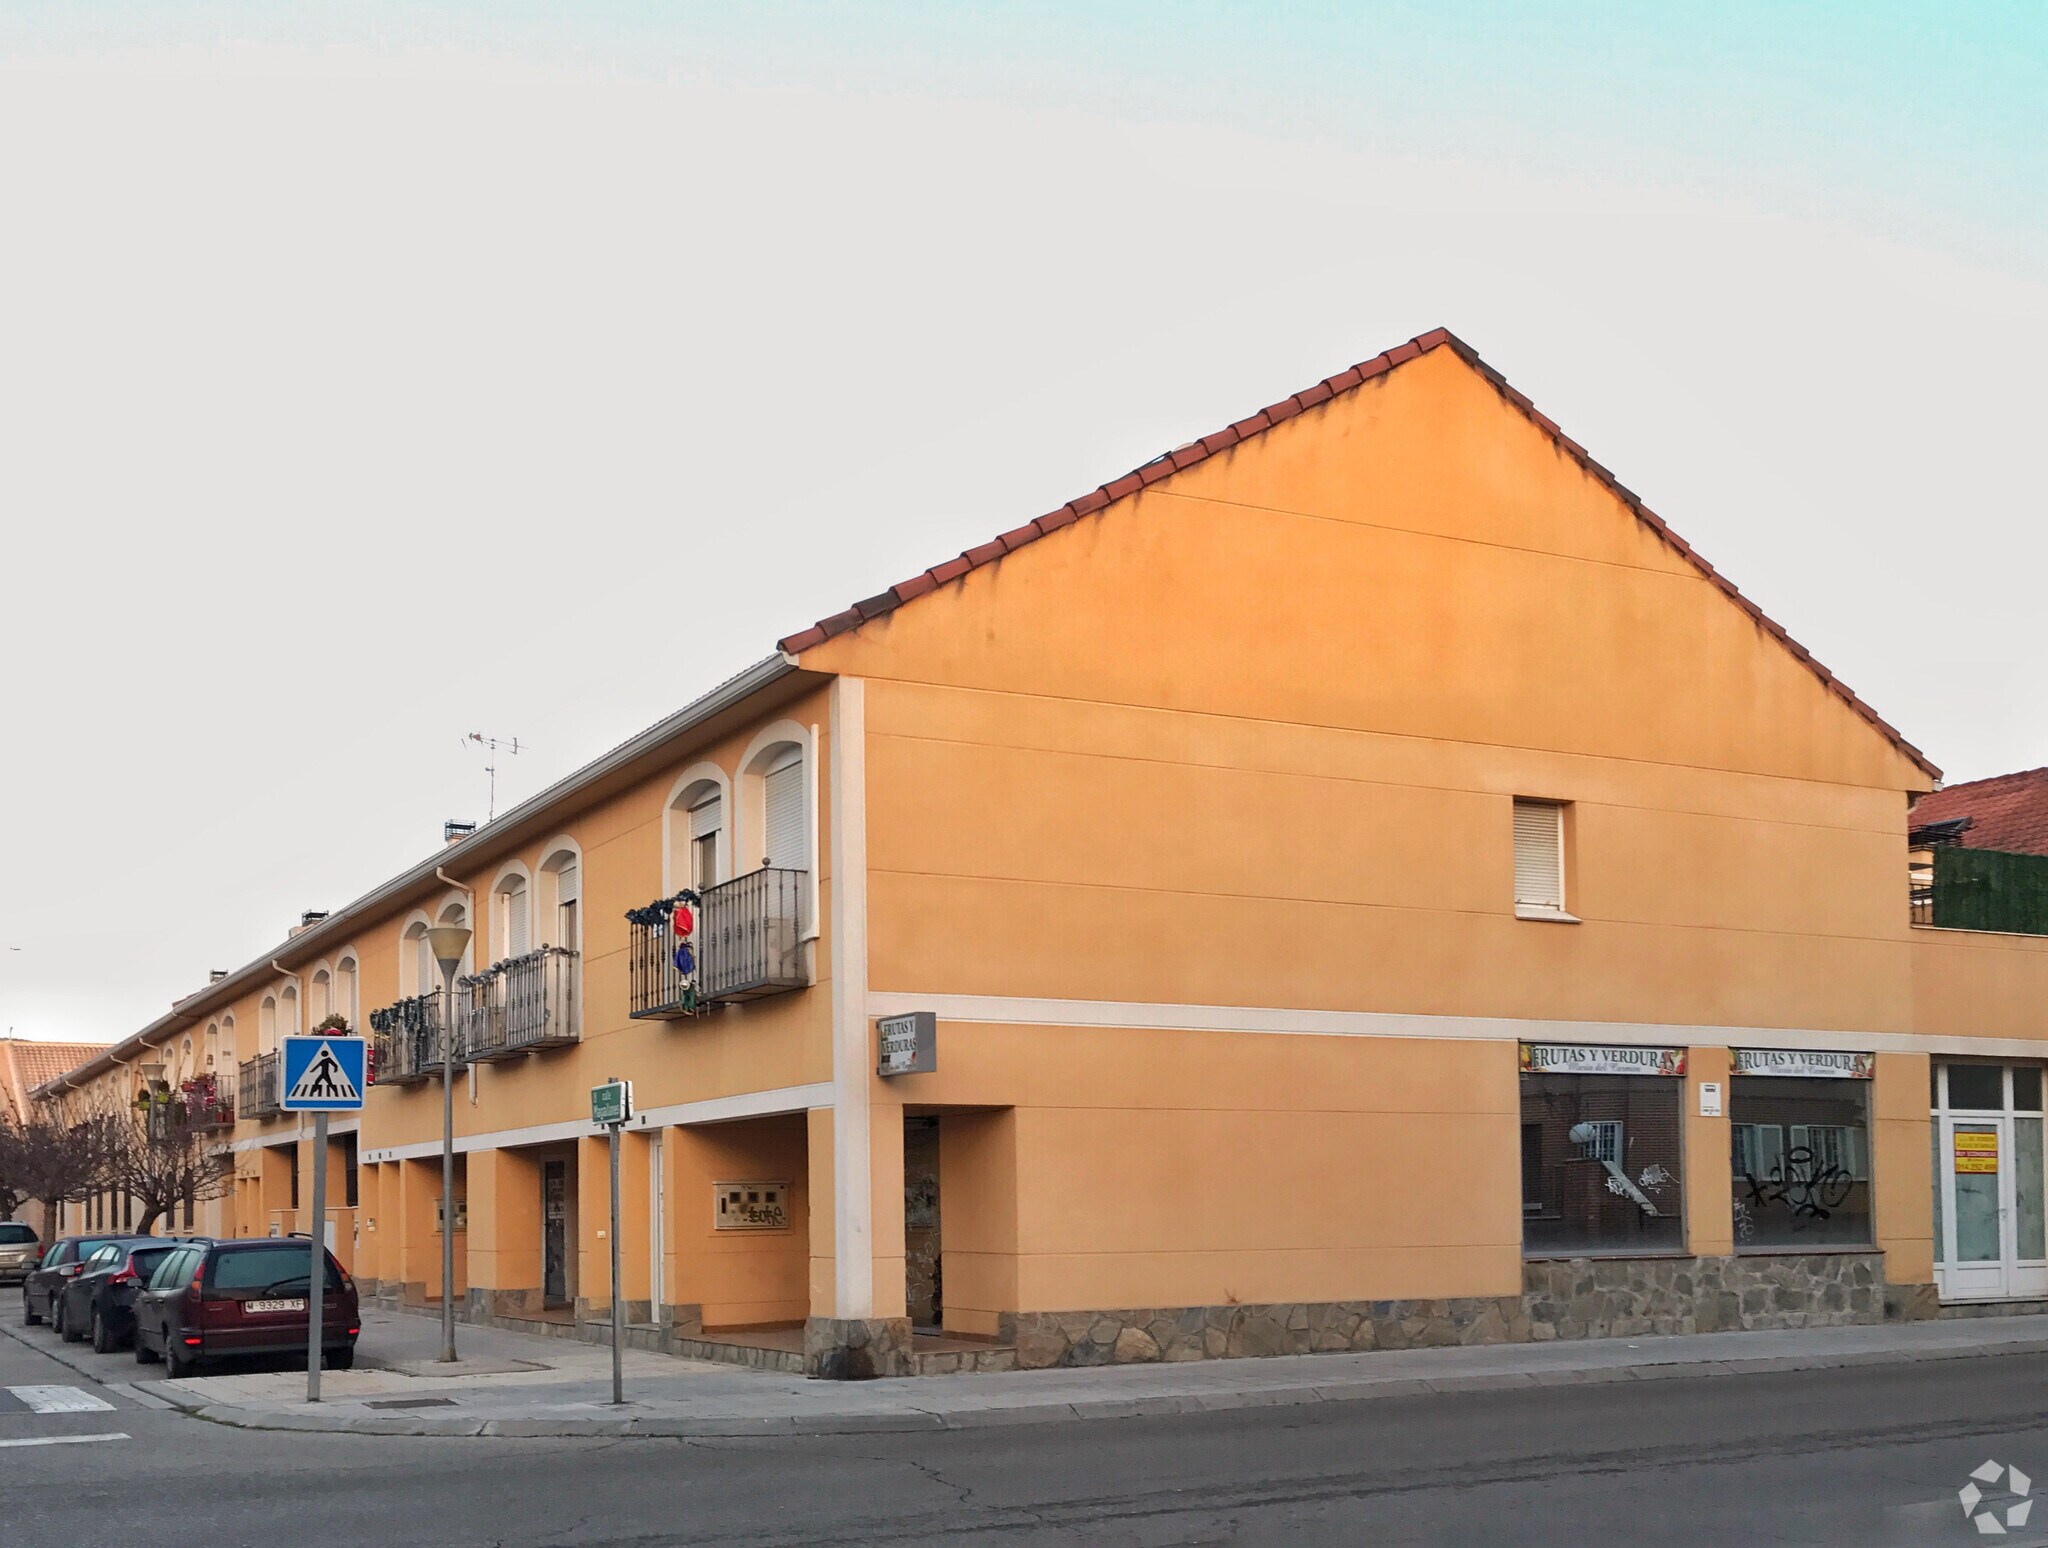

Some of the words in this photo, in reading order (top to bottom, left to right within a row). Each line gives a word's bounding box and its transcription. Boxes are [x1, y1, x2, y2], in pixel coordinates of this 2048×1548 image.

[884, 1020, 908, 1036] FRUTAS
[909, 1020, 914, 1032] Y
[881, 1038, 917, 1053] VERDURAS
[1532, 1048, 1585, 1067] FRUTAS
[1588, 1050, 1598, 1061] Y
[1601, 1050, 1675, 1070] VERDURAS
[1738, 1052, 1785, 1069] FRUTAS
[1787, 1053, 1796, 1065] Y
[1799, 1053, 1867, 1074] VERDURAS
[259, 1300, 285, 1310] 9329
